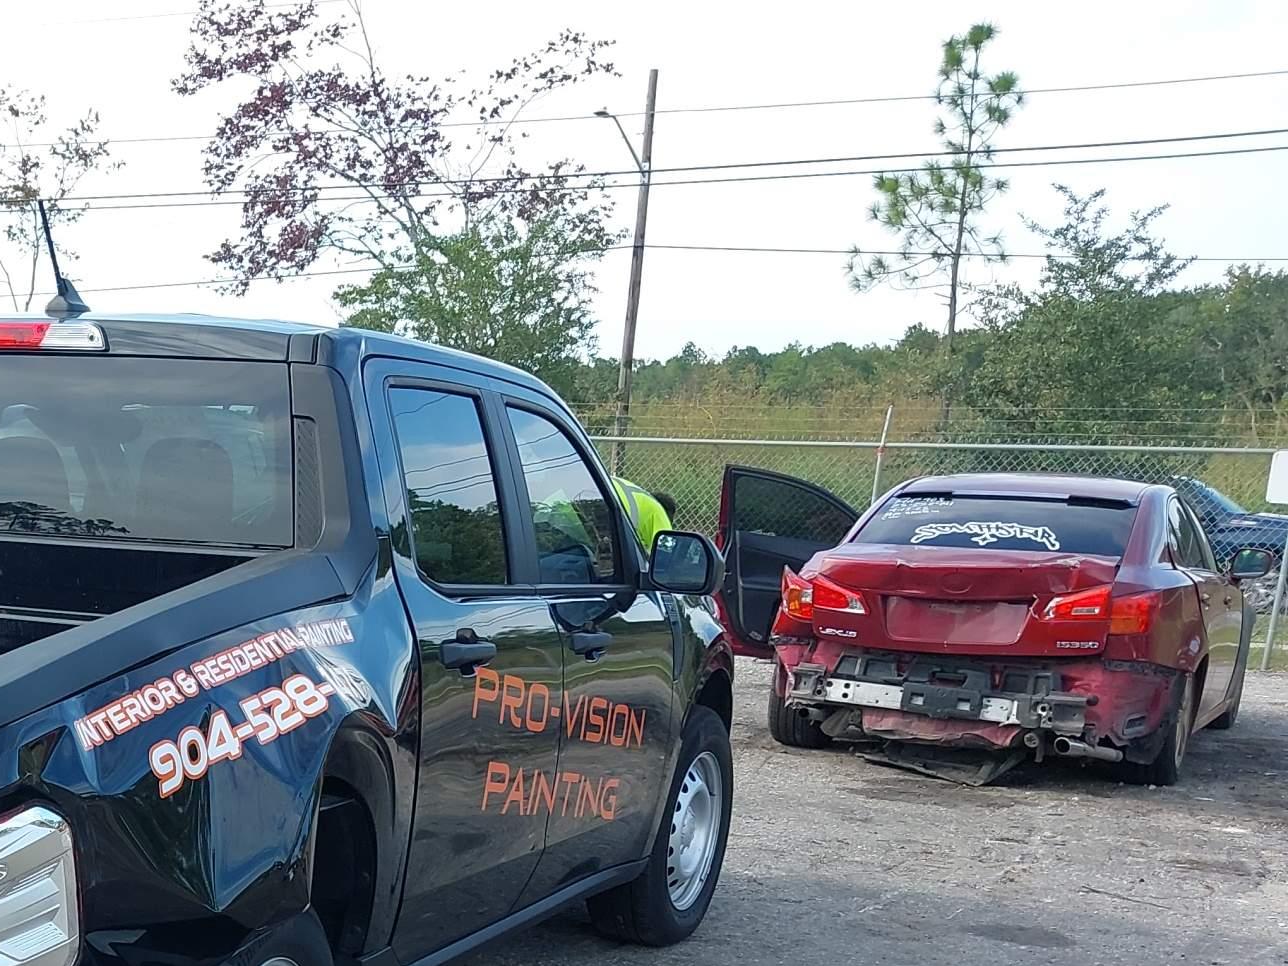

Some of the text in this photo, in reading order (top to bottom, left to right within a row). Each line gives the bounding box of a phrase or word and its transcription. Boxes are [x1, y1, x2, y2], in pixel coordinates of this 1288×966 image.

[819, 626, 857, 638] LEXUS
[74, 618, 355, 751] INTERIOR & RESIDENTIAL PAINTING
[472, 666, 647, 749] PRO-VISION
[481, 761, 620, 821] PAINTING
